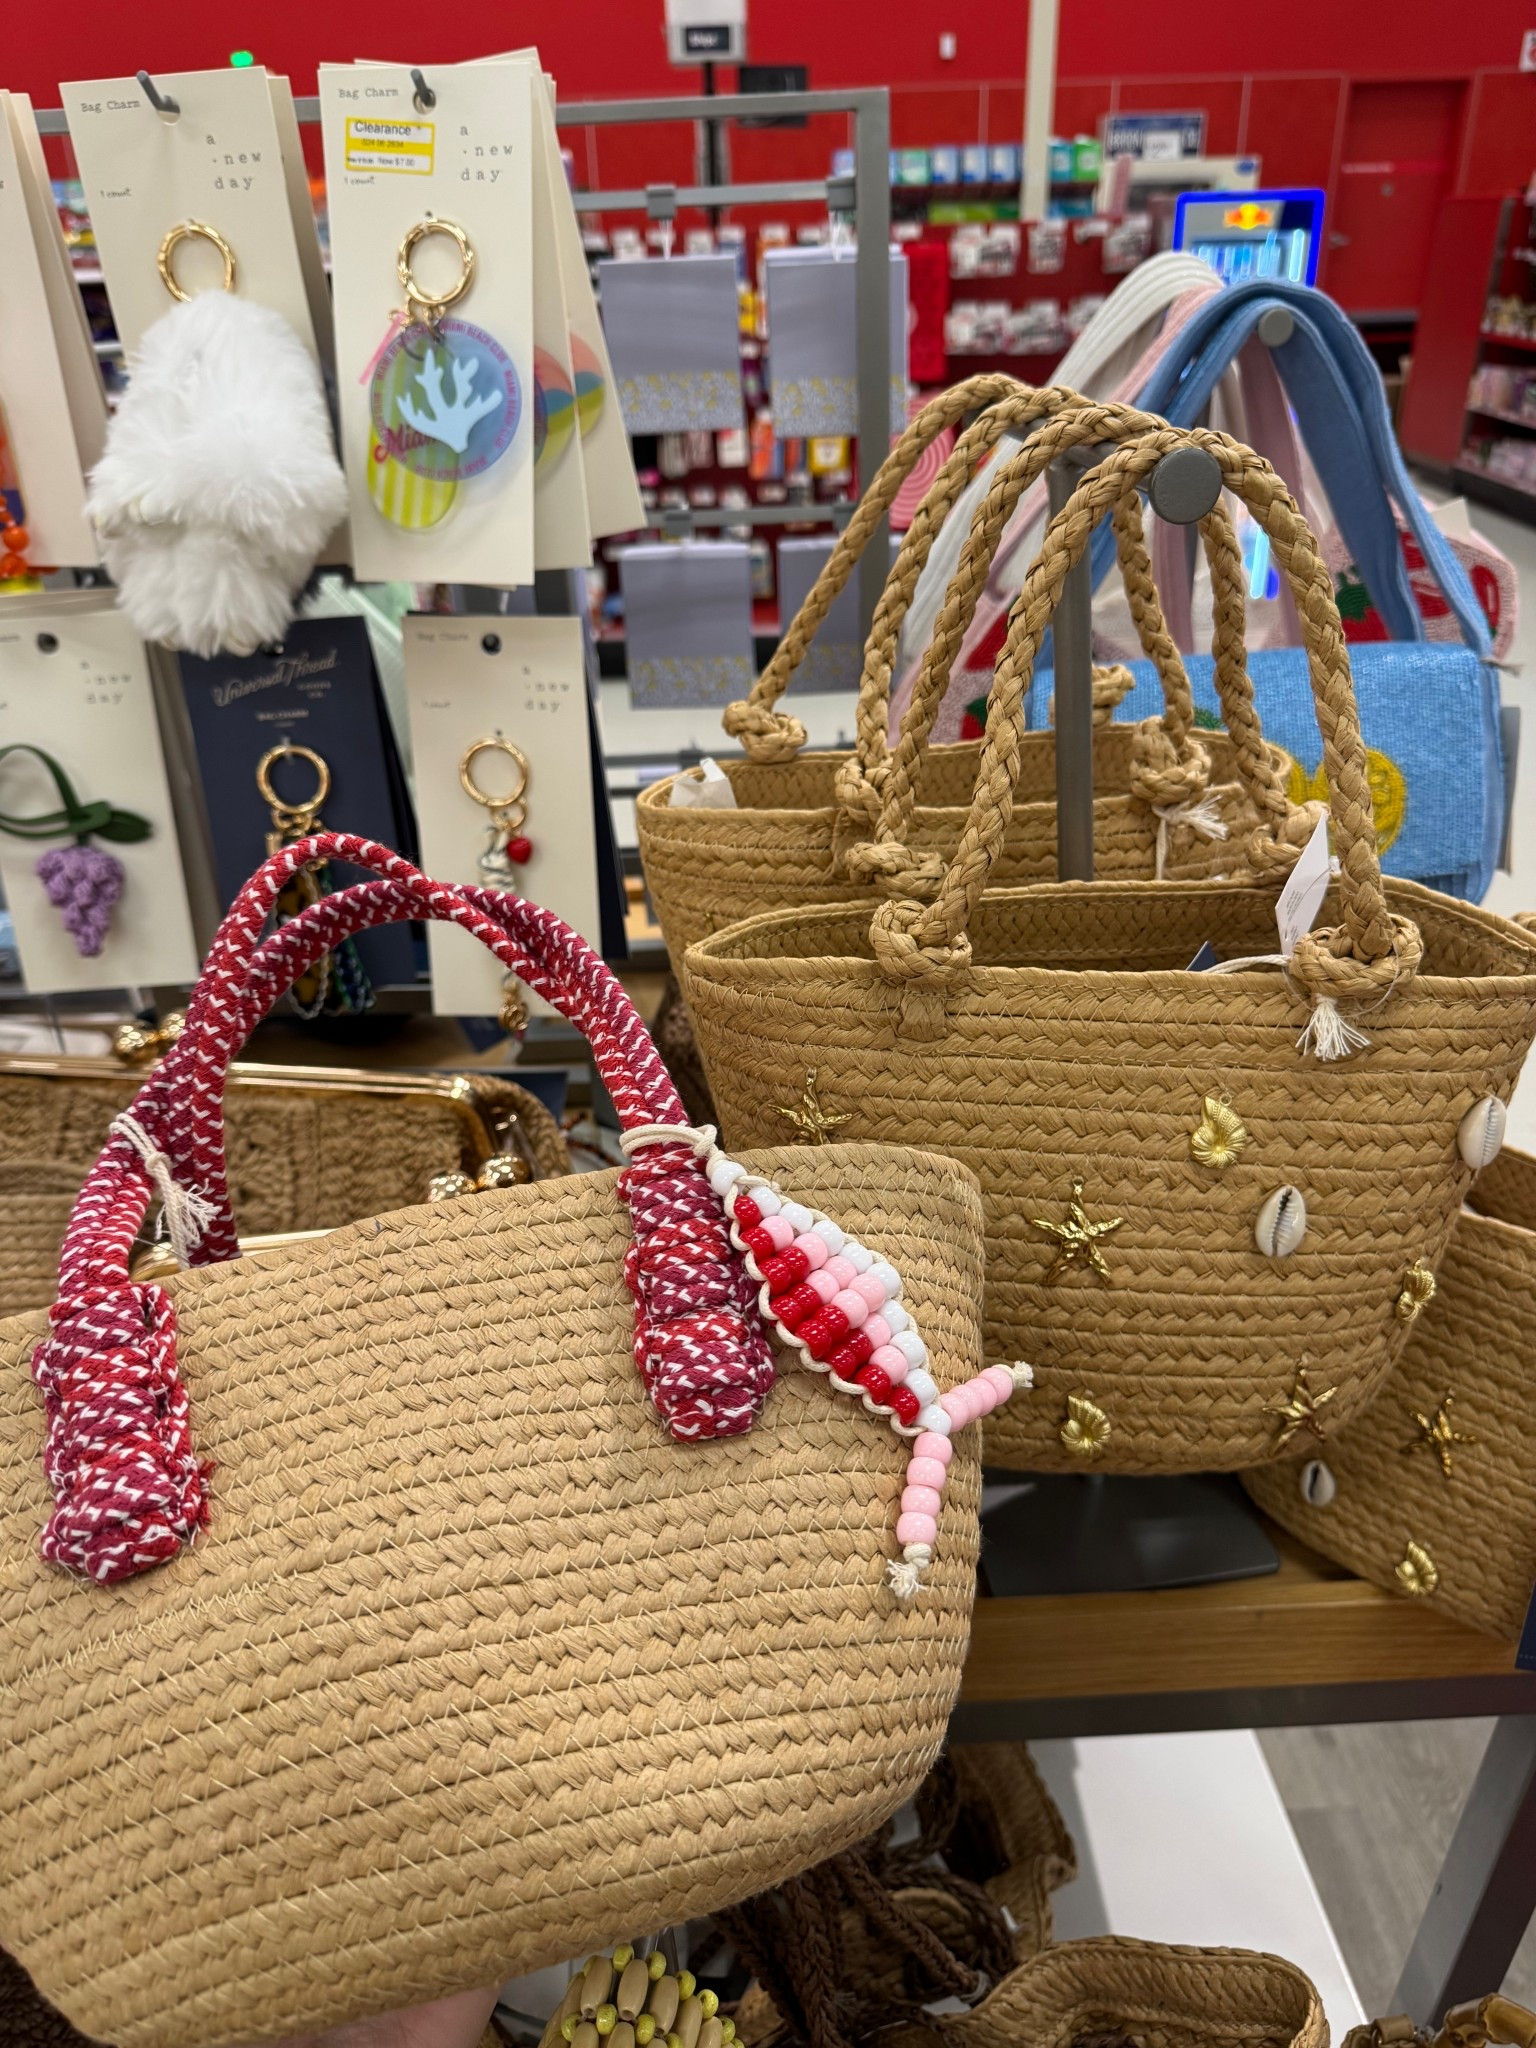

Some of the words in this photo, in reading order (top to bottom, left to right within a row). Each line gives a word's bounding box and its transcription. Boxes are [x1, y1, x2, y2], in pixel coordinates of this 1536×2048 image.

[338, 89, 359, 100] Bag
[365, 87, 399, 98] Charm
[81, 102, 102, 114] Bag
[107, 100, 141, 111] Charm
[354, 120, 412, 136] Clearance
[459, 126, 469, 136] a
[206, 135, 216, 145] a
[461, 168, 502, 183] day
[214, 176, 255, 191] day
